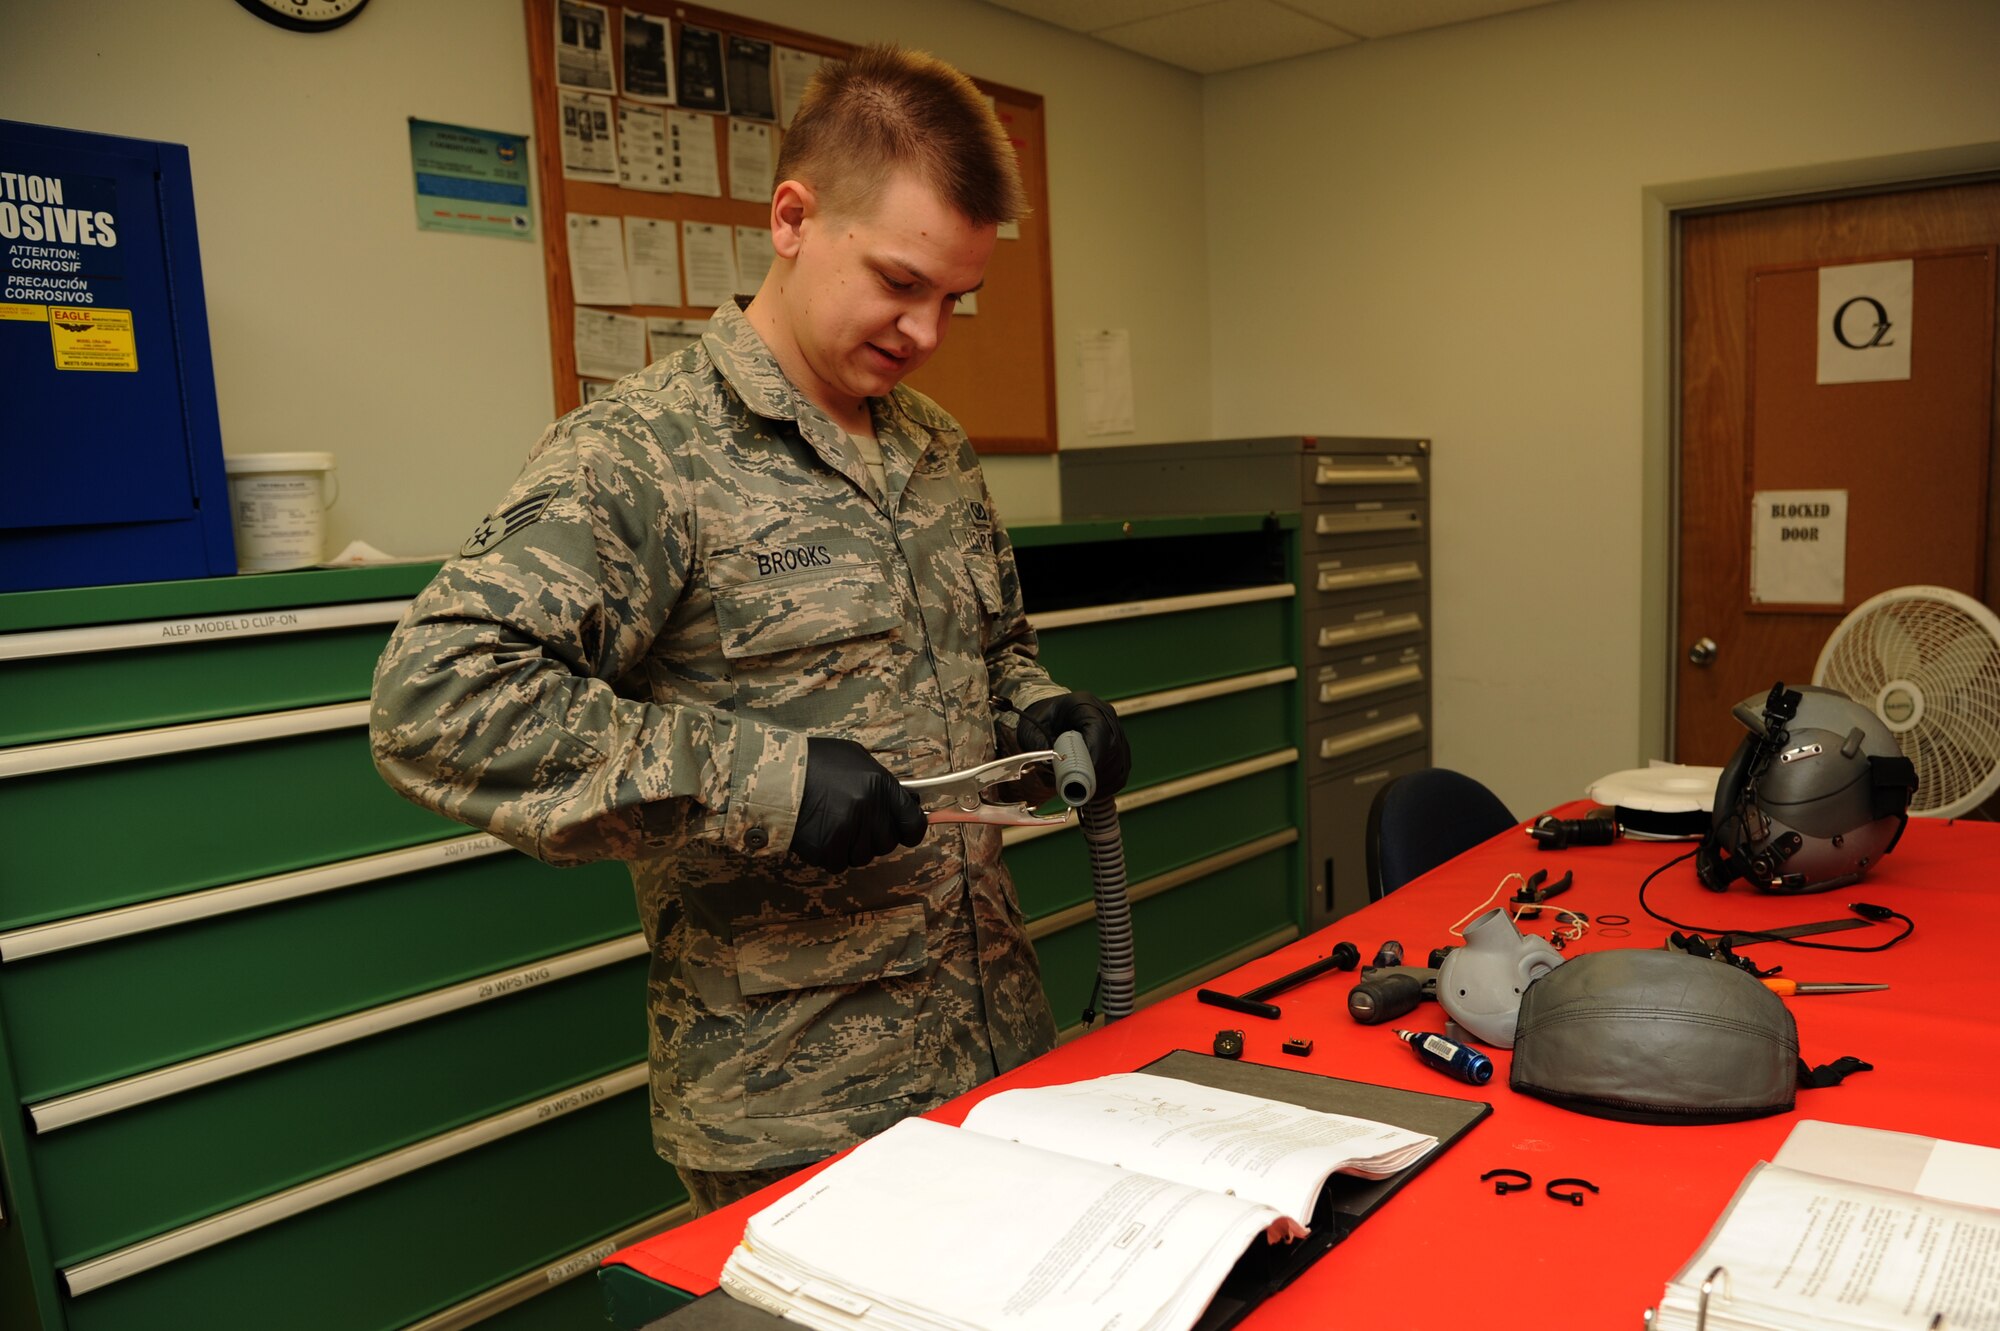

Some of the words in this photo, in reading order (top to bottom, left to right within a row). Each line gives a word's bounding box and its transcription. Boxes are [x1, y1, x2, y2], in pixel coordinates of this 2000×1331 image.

[0, 172, 63, 205] TION
[9, 245, 80, 260] ATTENTION:
[11, 257, 81, 272] CORROSIF
[8, 276, 87, 290] PRECAUCIÓN
[5, 287, 93, 303] CORROSIVOS
[54, 310, 90, 321] EAGLE
[1771, 504, 1830, 518] BLOCKED
[1781, 528, 1819, 541] DOOR
[757, 545, 831, 576] BROOKS
[162, 624, 190, 637] ALEP
[195, 620, 238, 634] MODEL
[242, 619, 249, 630] D
[252, 613, 297, 629] CLIP-ON
[478, 984, 493, 997] 29
[495, 976, 522, 993] WPS
[524, 967, 550, 984] NVG
[537, 1105, 551, 1118] 29
[552, 1095, 579, 1112] WPS
[579, 1086, 604, 1102] NVG
